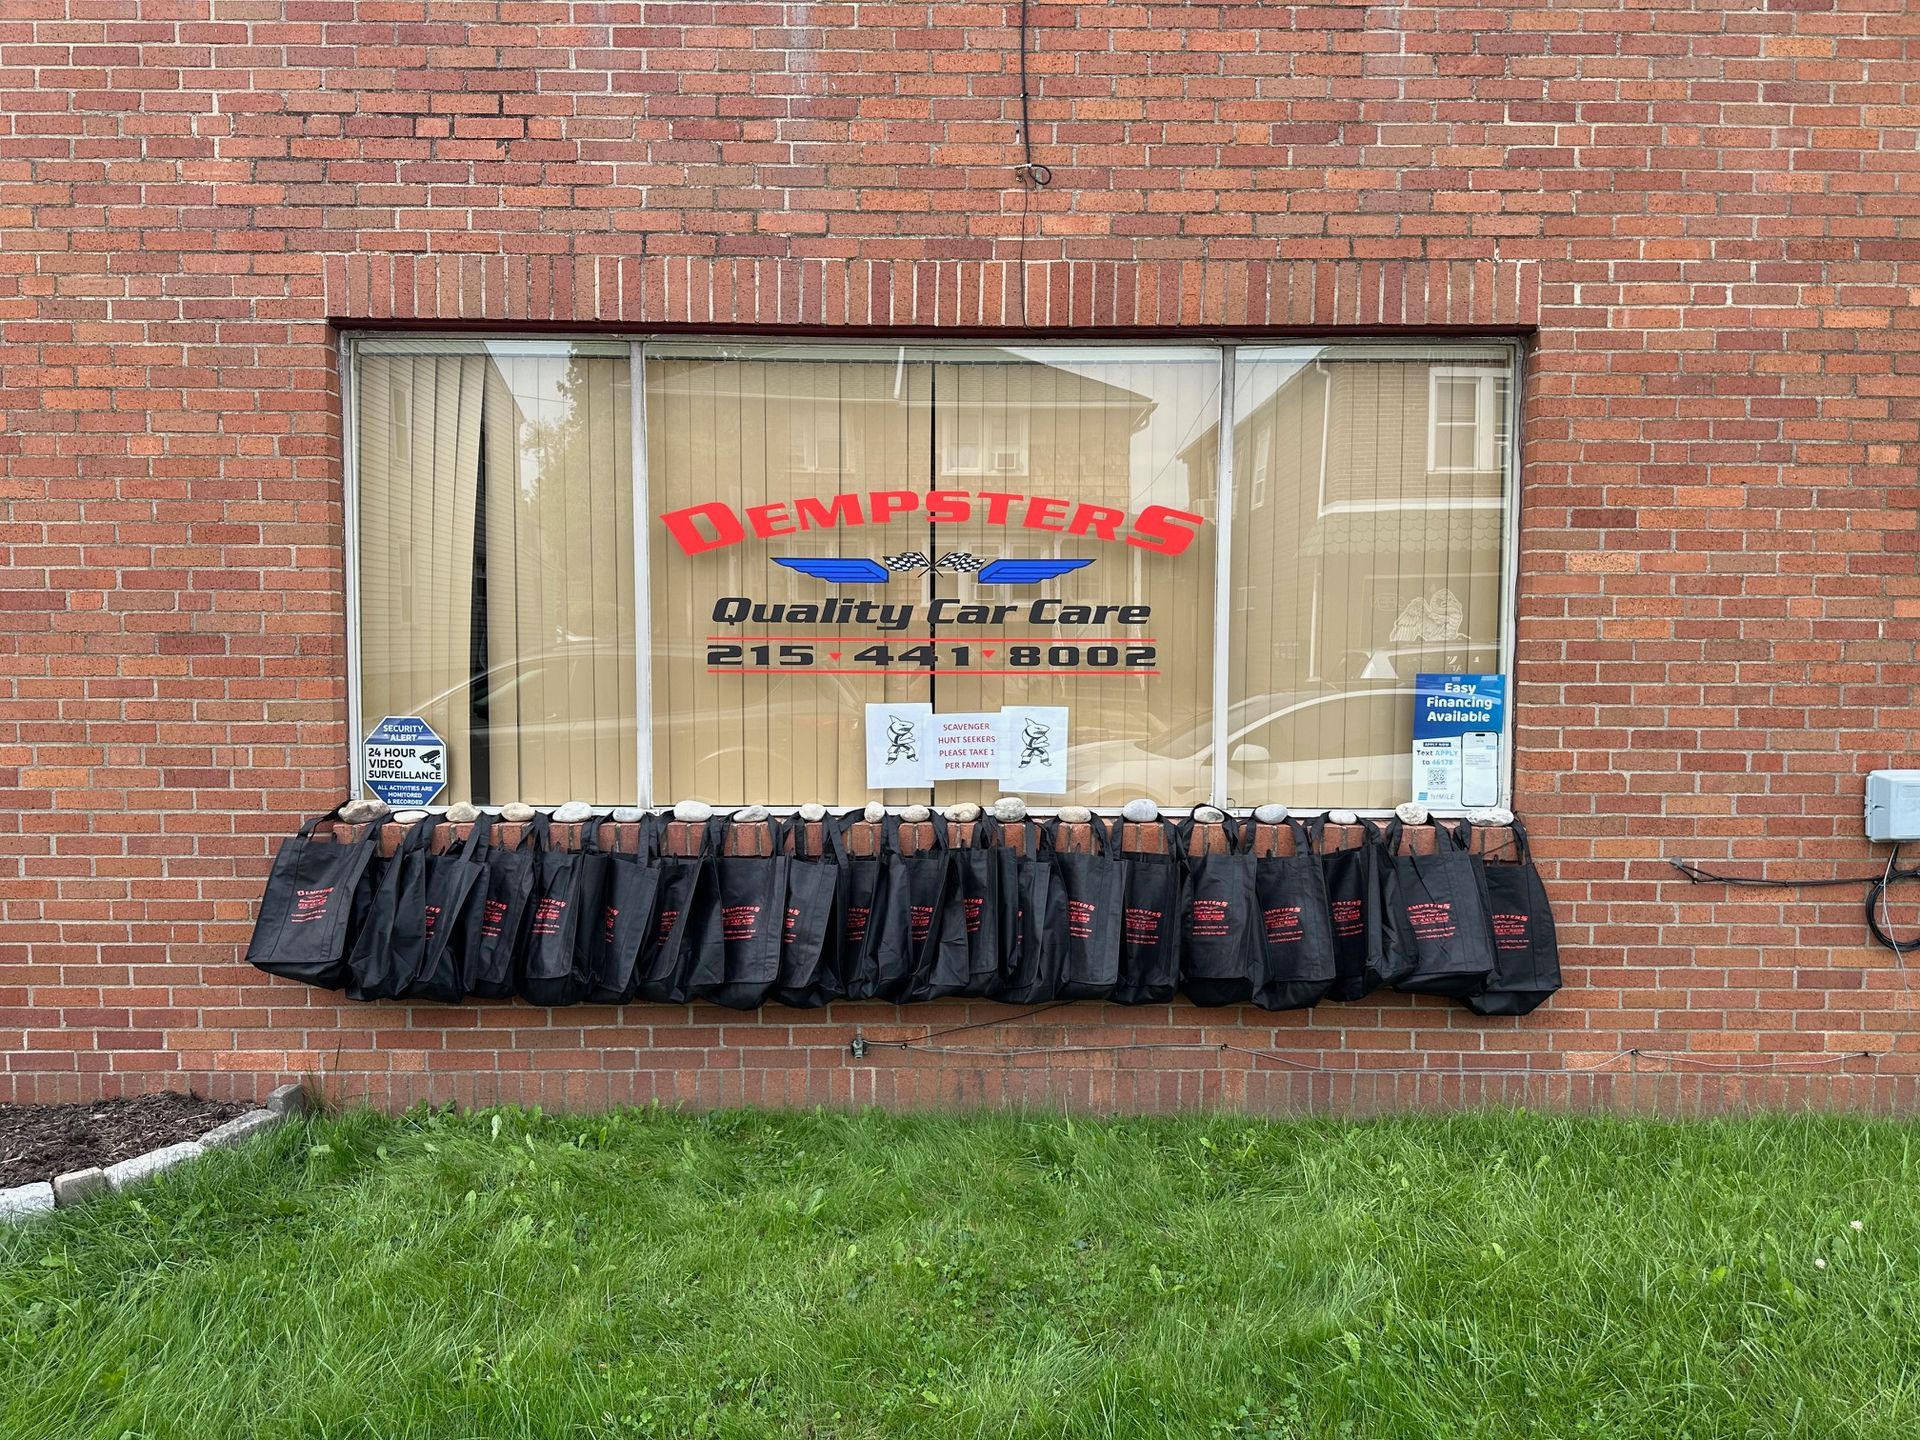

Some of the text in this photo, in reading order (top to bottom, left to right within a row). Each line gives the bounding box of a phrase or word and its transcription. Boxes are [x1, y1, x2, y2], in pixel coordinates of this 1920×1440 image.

[659, 490, 1204, 557] DEMPSTERS
[712, 597, 1152, 631] Quality Car Care
[707, 644, 1157, 667] 215 441 8002
[1444, 683, 1476, 694] Easy
[1426, 697, 1493, 710] Financing
[1427, 711, 1490, 722] Available
[383, 724, 424, 732] SECURITY
[943, 723, 991, 732] SCAVENGER
[390, 734, 418, 742] ALERT
[938, 735, 996, 744] HUNT SEEKERS
[368, 748, 416, 757] 24 HOUR
[939, 749, 967, 757] PLEASE
[369, 759, 403, 769] VIDEO
[945, 761, 990, 770] PER FAMILY
[368, 770, 442, 780] SURVEILLANCE
[1407, 903, 1451, 911] EMPSTERS
